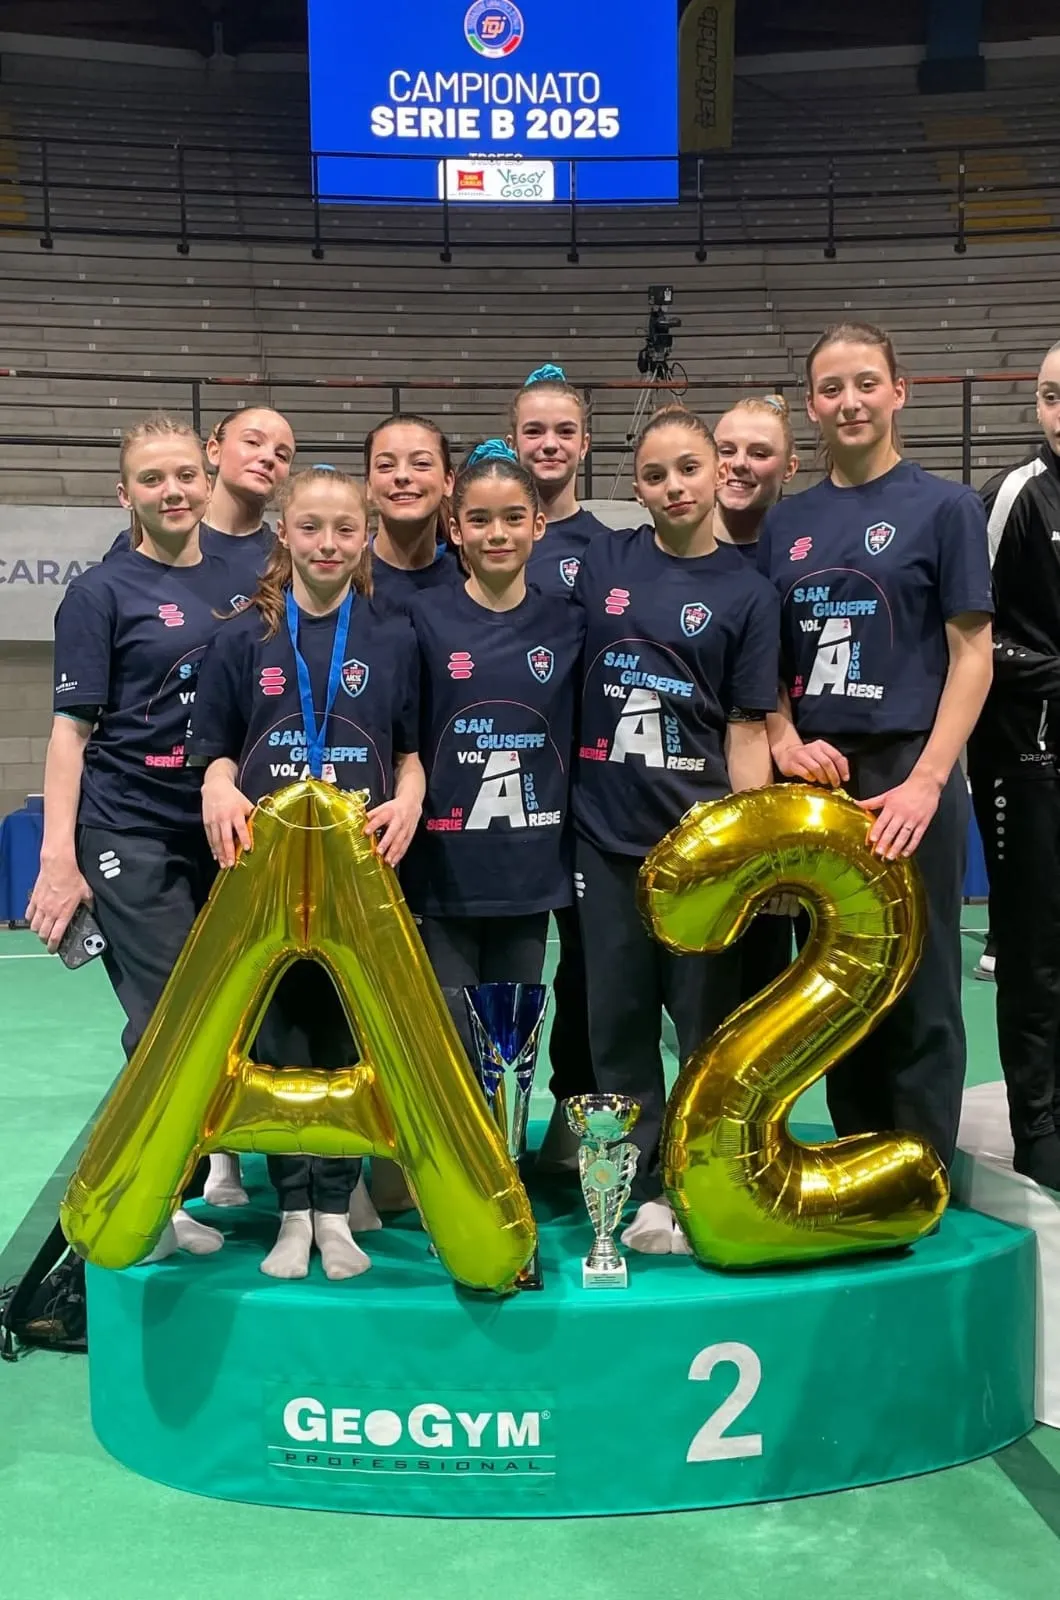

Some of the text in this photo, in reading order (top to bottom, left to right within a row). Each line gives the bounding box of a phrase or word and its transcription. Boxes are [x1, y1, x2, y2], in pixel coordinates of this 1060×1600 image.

[389, 71, 600, 104] CAMPIONATO
[371, 106, 620, 139] SERIE B 2025
[497, 169, 546, 185] VEGGY
[500, 184, 543, 198] GOOD
[793, 586, 830, 603] SAN
[812, 599, 878, 617] GIUSEPPE
[800, 620, 821, 632] VOL
[603, 652, 640, 670] SAN
[805, 618, 852, 696] A
[848, 641, 861, 680] 2025
[603, 684, 627, 699] VOL
[620, 670, 694, 698] GIUSEPPE
[846, 683, 884, 700] RESE
[453, 718, 494, 734] SAN
[608, 687, 665, 768] A
[664, 714, 682, 753] 2025
[268, 731, 307, 746] SAN
[476, 733, 546, 749] GIUSEPPE
[144, 755, 185, 768] SERIE
[290, 747, 368, 762] GISEPPE
[457, 751, 486, 764] VOL
[510, 752, 517, 761] 2
[270, 764, 299, 776] VOL
[325, 765, 333, 775] 2
[666, 756, 706, 772] RESE
[465, 750, 529, 830] A
[523, 773, 539, 811] 2025
[452, 808, 463, 818] IN
[529, 811, 561, 827] RESE
[426, 819, 463, 831] SERIE
[686, 1341, 764, 1464] 2
[285, 1453, 542, 1471] PROFESSIONAL
